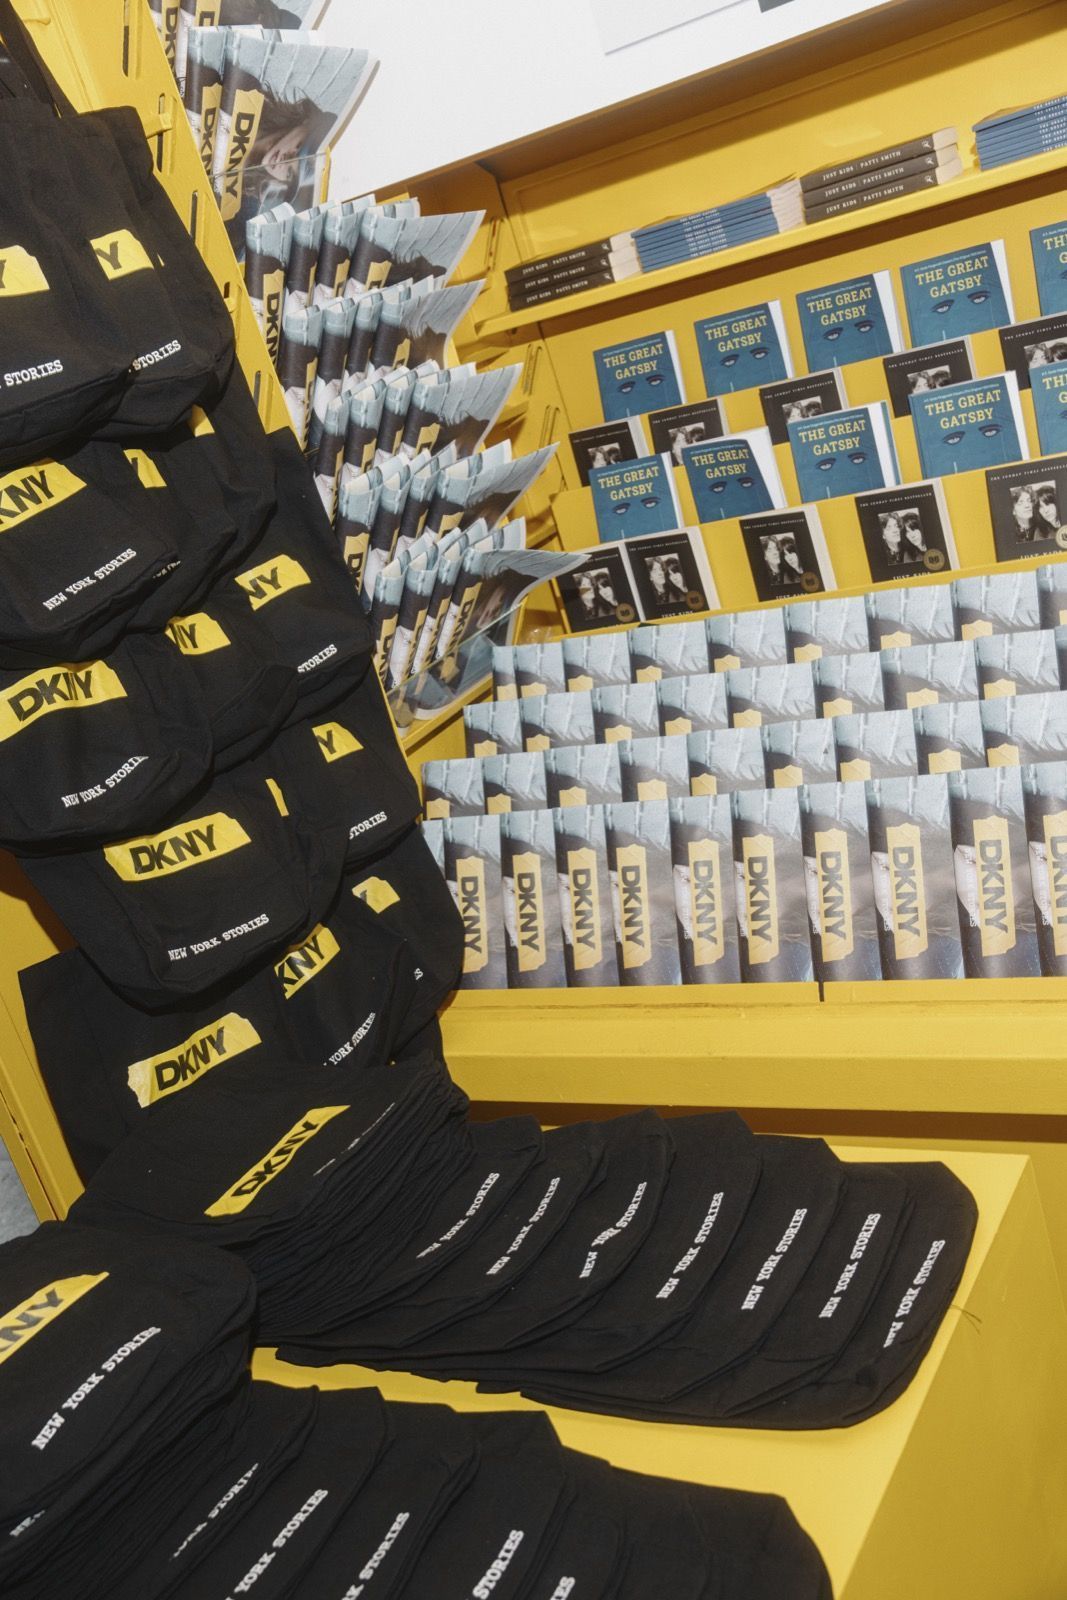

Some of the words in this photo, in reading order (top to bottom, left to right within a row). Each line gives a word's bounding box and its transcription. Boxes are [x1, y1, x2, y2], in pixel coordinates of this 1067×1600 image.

[201, 107, 216, 176] DKN
[226, 112, 254, 199] DKNY
[823, 172, 837, 181] JUST
[838, 166, 854, 175] KIDS
[860, 158, 879, 168] PATTI
[880, 151, 901, 161] SMITH
[825, 188, 839, 197] JUST
[842, 182, 856, 191] KIDS
[863, 174, 882, 184] PATTI
[884, 168, 904, 178] SMITH
[826, 204, 840, 214] JUST
[842, 200, 856, 208] KIDS
[864, 192, 882, 202] PATTI
[884, 185, 904, 196] SMITH
[916, 268, 944, 286] THE
[947, 256, 988, 276] GREAT
[930, 274, 982, 298] GATSBY
[807, 294, 834, 314] THE
[836, 288, 872, 306] GREAT
[820, 305, 866, 326] GATSBY
[704, 323, 730, 340] THE
[732, 315, 768, 333] GREAT
[718, 332, 762, 353] GATSBY
[4, 360, 64, 387] STORIES
[132, 340, 182, 371] STORIES
[604, 351, 627, 368] THE
[628, 343, 664, 361] GREAT
[615, 360, 658, 380] GATSBY
[925, 398, 955, 416] THE
[960, 390, 1001, 408] GREAT
[940, 408, 994, 430] GATSBY
[692, 450, 714, 466] THE
[717, 449, 750, 462] GREAT
[798, 427, 826, 444] THE
[829, 420, 866, 436] GREAT
[813, 437, 860, 456] GATSBY
[0, 470, 54, 524] KNY
[598, 472, 622, 488] THE
[624, 466, 660, 484] GREAT
[610, 483, 654, 501] GATSBY
[706, 464, 747, 480] GATSBY
[42, 592, 68, 610] NEW
[66, 576, 96, 596] YORK
[94, 548, 136, 580] STORIES
[297, 644, 338, 674] STORIES
[61, 793, 79, 808] NEW
[80, 784, 106, 803] YORK
[130, 824, 216, 874] DKNY
[349, 811, 388, 840] STORIES
[518, 872, 540, 952] DKNY
[572, 868, 596, 951] DKNY
[622, 865, 645, 948] DKNY
[694, 860, 718, 944] DKNY
[748, 856, 772, 943] DKNY
[820, 852, 846, 940] DKNY
[893, 846, 920, 938] DKNY
[979, 840, 1008, 934] DKNY
[168, 947, 188, 961] NEW
[190, 936, 222, 955] YORK
[222, 914, 270, 941] STORIES
[461, 876, 482, 954] DKNY
[277, 934, 325, 991] KNY
[154, 1026, 226, 1091] DKNY
[328, 1042, 354, 1066] YORK
[231, 1121, 319, 1197] DKNY
[440, 1218, 469, 1241] YORK
[466, 1172, 500, 1216] STORIES
[486, 1256, 510, 1276] NEW
[506, 1224, 533, 1254] YORK
[529, 1177, 560, 1222] STORIES
[579, 1251, 598, 1278] NEW
[591, 1228, 622, 1247] YORK
[616, 1182, 648, 1228] STORIES
[656, 1277, 680, 1299] NEW
[673, 1246, 701, 1274] YORK
[694, 1192, 724, 1244] STORIES
[741, 1285, 764, 1310] NEW
[756, 1254, 783, 1282] YORK
[776, 1208, 808, 1254] STORIES
[818, 1296, 842, 1318] NEW
[834, 1262, 858, 1294] YORK
[850, 1213, 881, 1260] STORIES
[895, 1286, 922, 1318] YORK
[913, 1240, 946, 1286] STORIES
[31, 1412, 66, 1450] NEW
[62, 1372, 104, 1410] YORK
[102, 1326, 162, 1372] STORIES
[234, 1552, 276, 1593] YORK
[272, 1488, 329, 1548] STORIES
[359, 1512, 410, 1580] STORIES
[472, 1530, 524, 1600] STORIES
